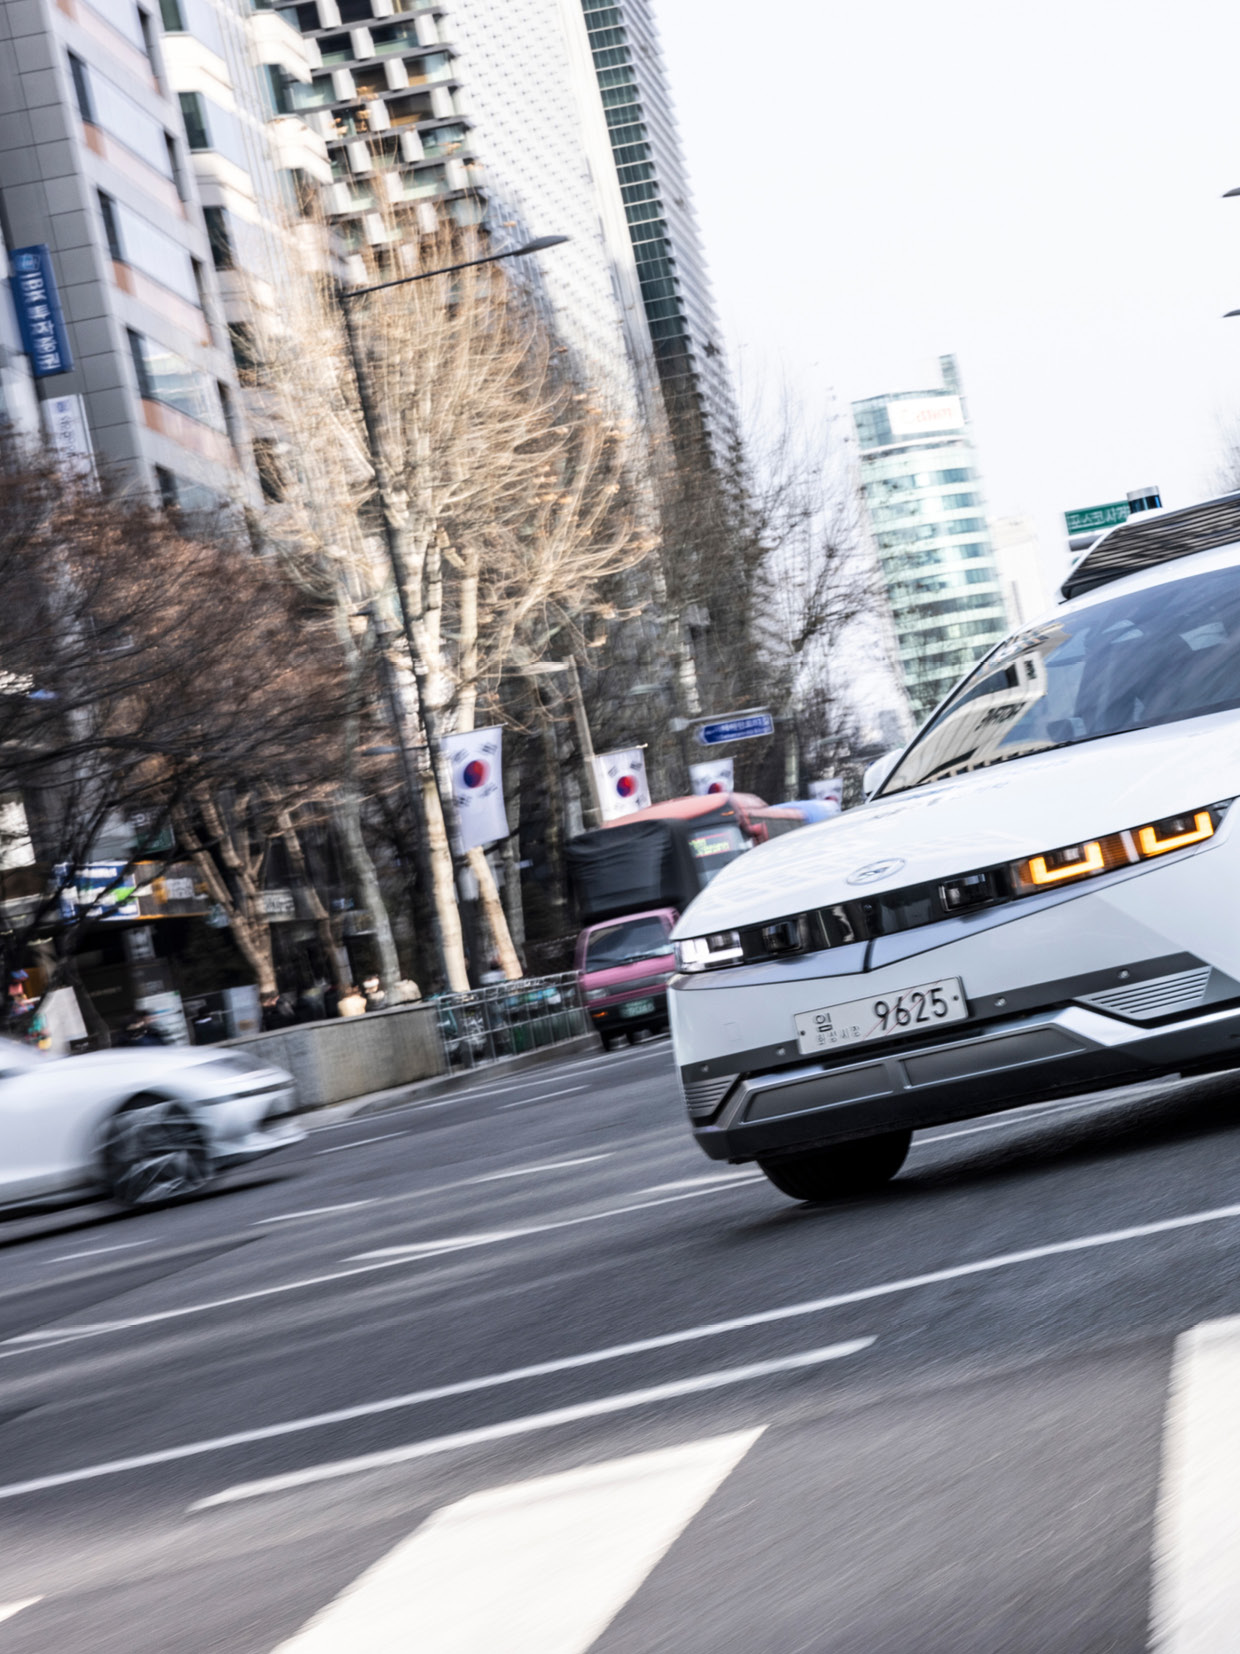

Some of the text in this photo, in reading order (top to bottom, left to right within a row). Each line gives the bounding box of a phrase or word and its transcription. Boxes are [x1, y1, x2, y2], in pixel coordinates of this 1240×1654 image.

[1067, 505, 1131, 529] 포스코사거
[814, 987, 949, 1032] 임 9625
